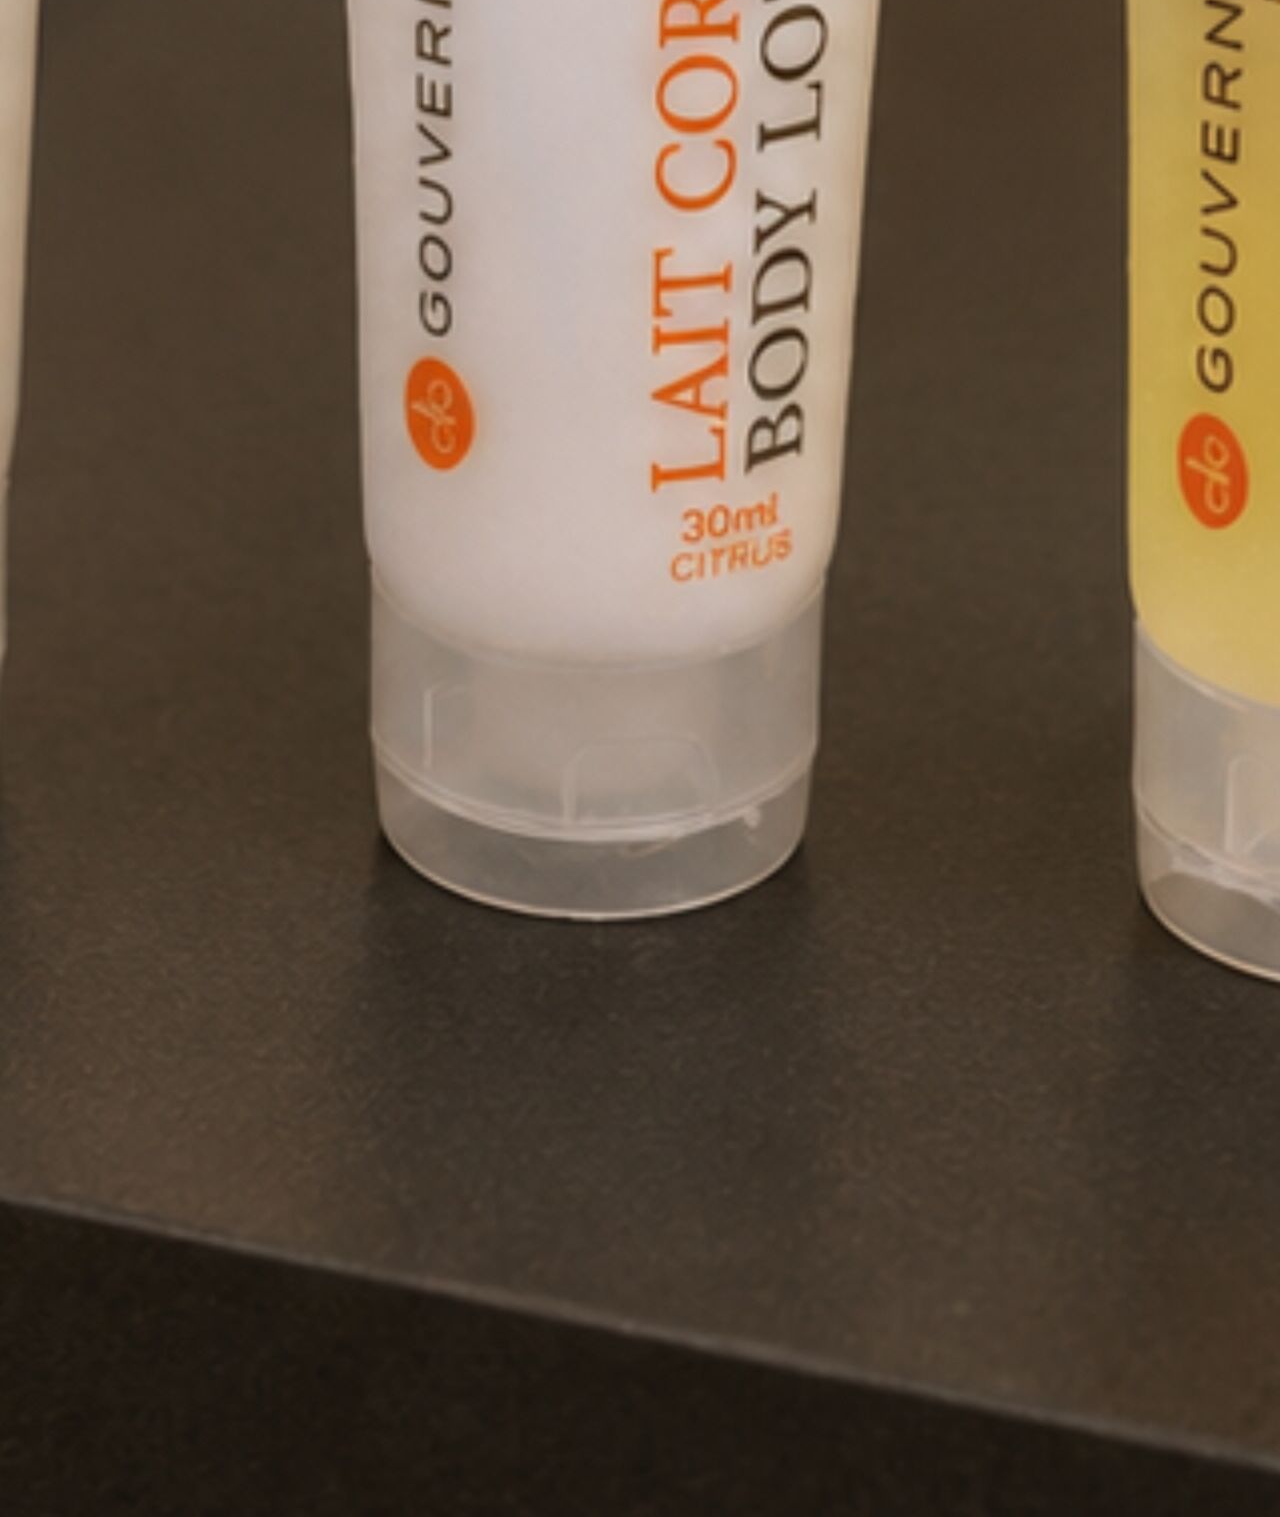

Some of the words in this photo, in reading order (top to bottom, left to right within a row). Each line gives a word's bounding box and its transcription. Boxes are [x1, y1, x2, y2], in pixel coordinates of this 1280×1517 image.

[651, 247, 734, 493] LAIT
[744, 188, 818, 474] BODY
[681, 491, 779, 545] 30ml
